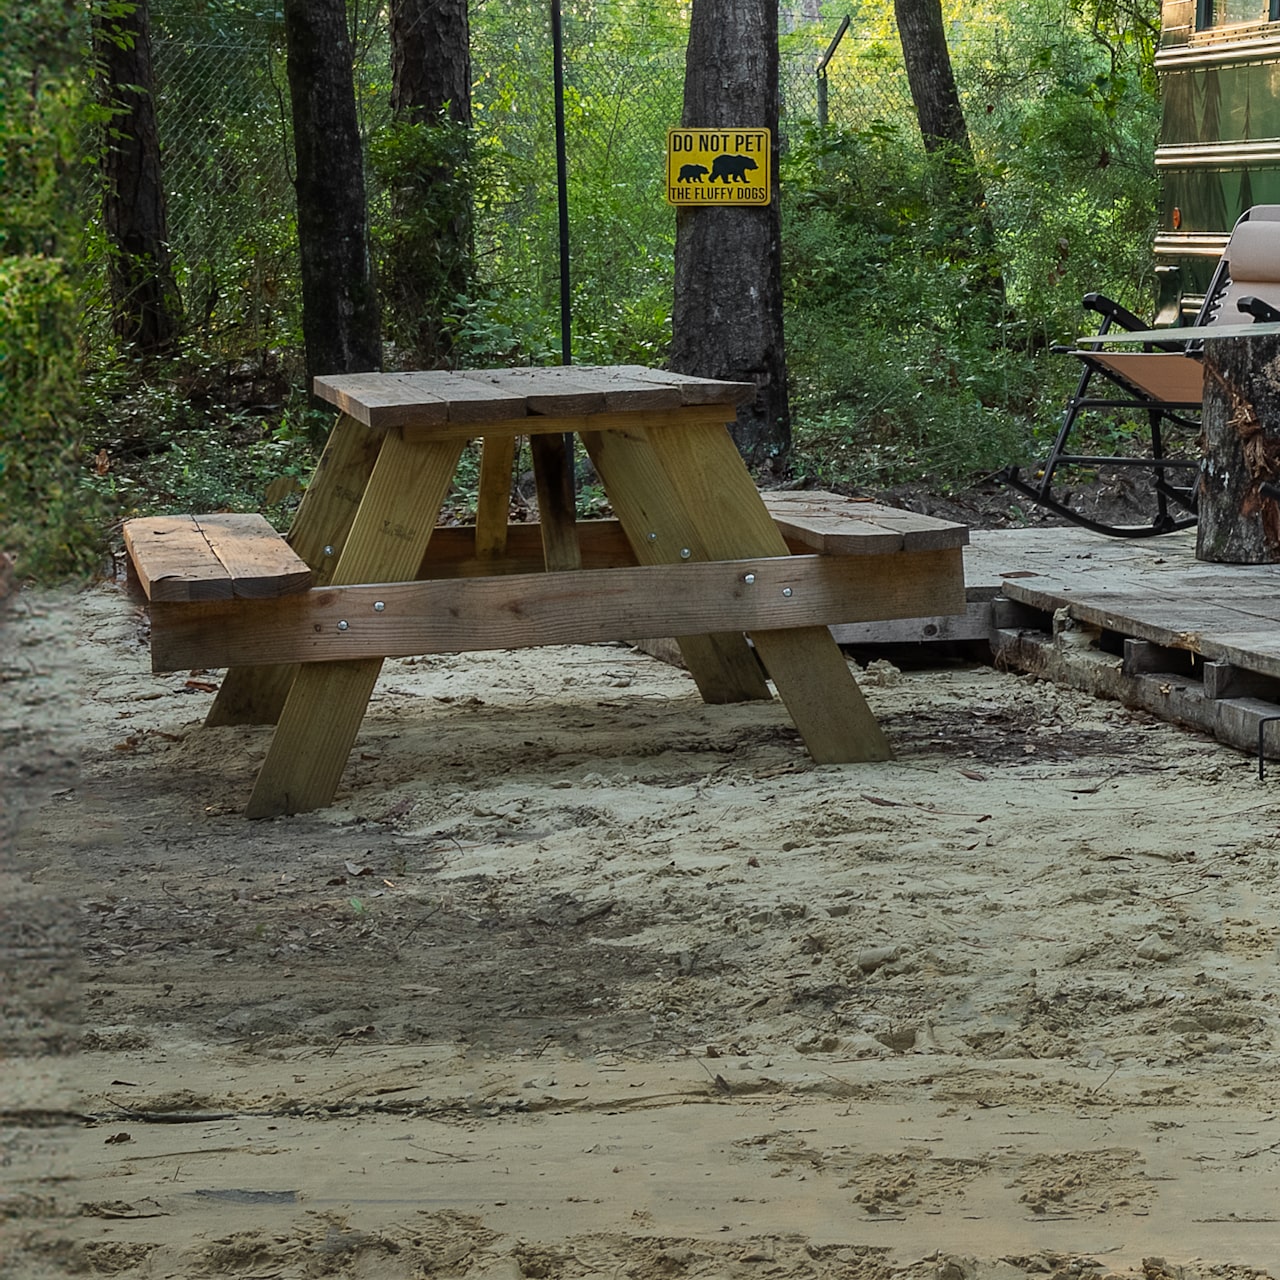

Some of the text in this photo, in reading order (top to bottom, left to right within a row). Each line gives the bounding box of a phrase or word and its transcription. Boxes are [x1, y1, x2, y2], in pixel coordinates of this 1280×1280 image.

[673, 134, 764, 152] DO NOT PET
[671, 187, 765, 200] THE FLUFFY DOGS
